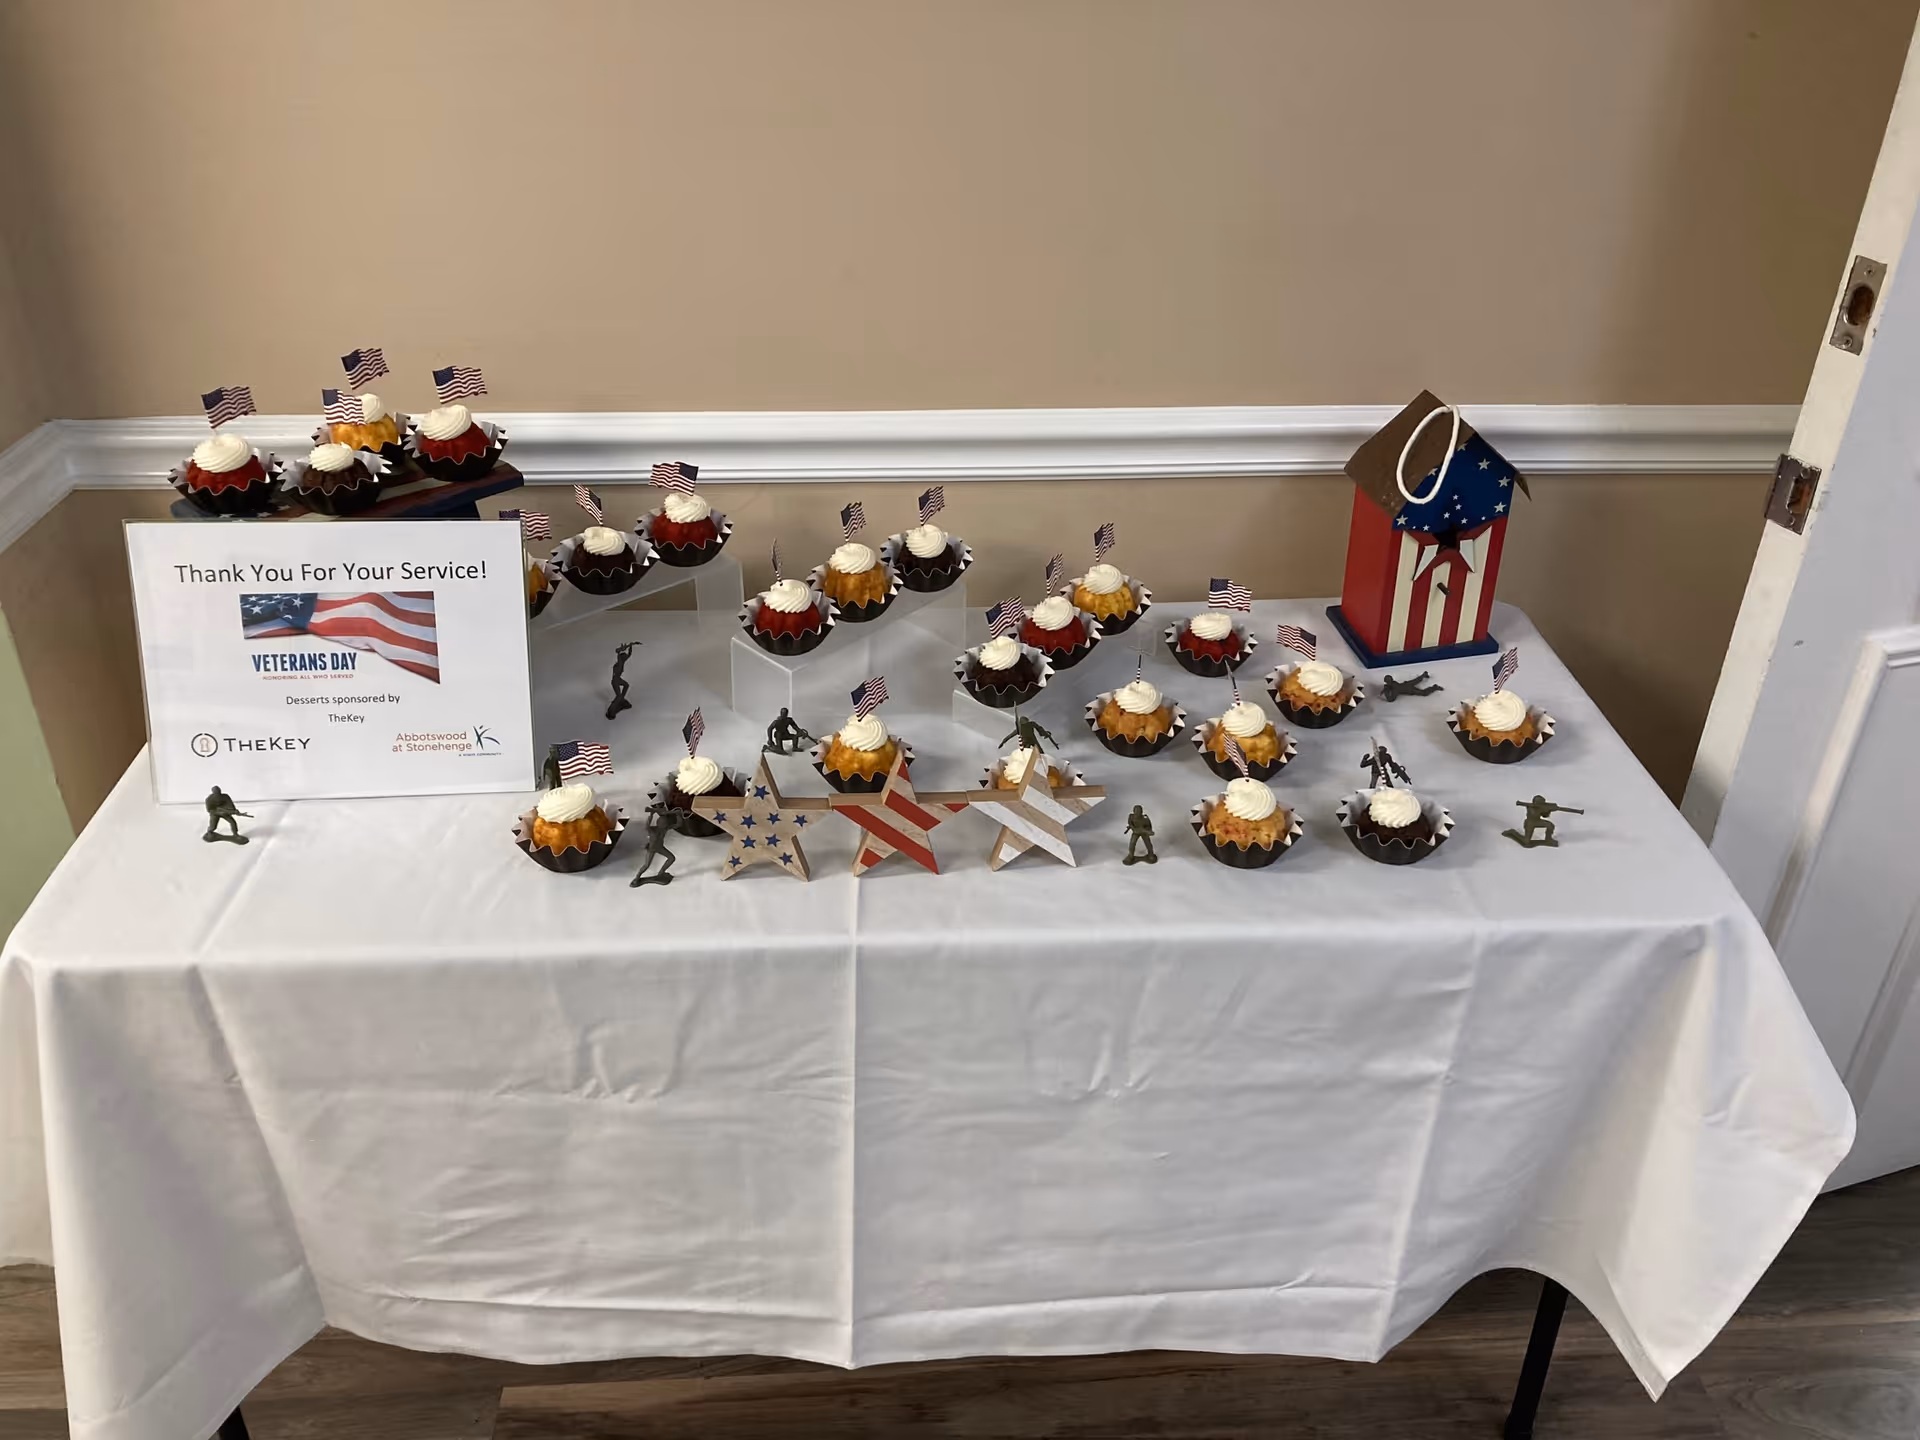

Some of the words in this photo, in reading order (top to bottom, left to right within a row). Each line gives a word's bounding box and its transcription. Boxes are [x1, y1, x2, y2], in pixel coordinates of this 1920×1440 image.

[174, 564, 245, 583] Thank
[250, 564, 293, 582] You
[300, 564, 336, 581] For
[343, 562, 394, 580] Your
[400, 560, 487, 580] Service!
[252, 653, 327, 672] VETERANS
[331, 652, 357, 670] DAY
[286, 696, 330, 705] Desserts
[332, 694, 385, 706] sponsored
[388, 694, 400, 704] by
[328, 714, 365, 724] TheKey
[396, 731, 467, 742] Abbotswood
[392, 744, 402, 752] at
[406, 742, 472, 752] Stonehenge
